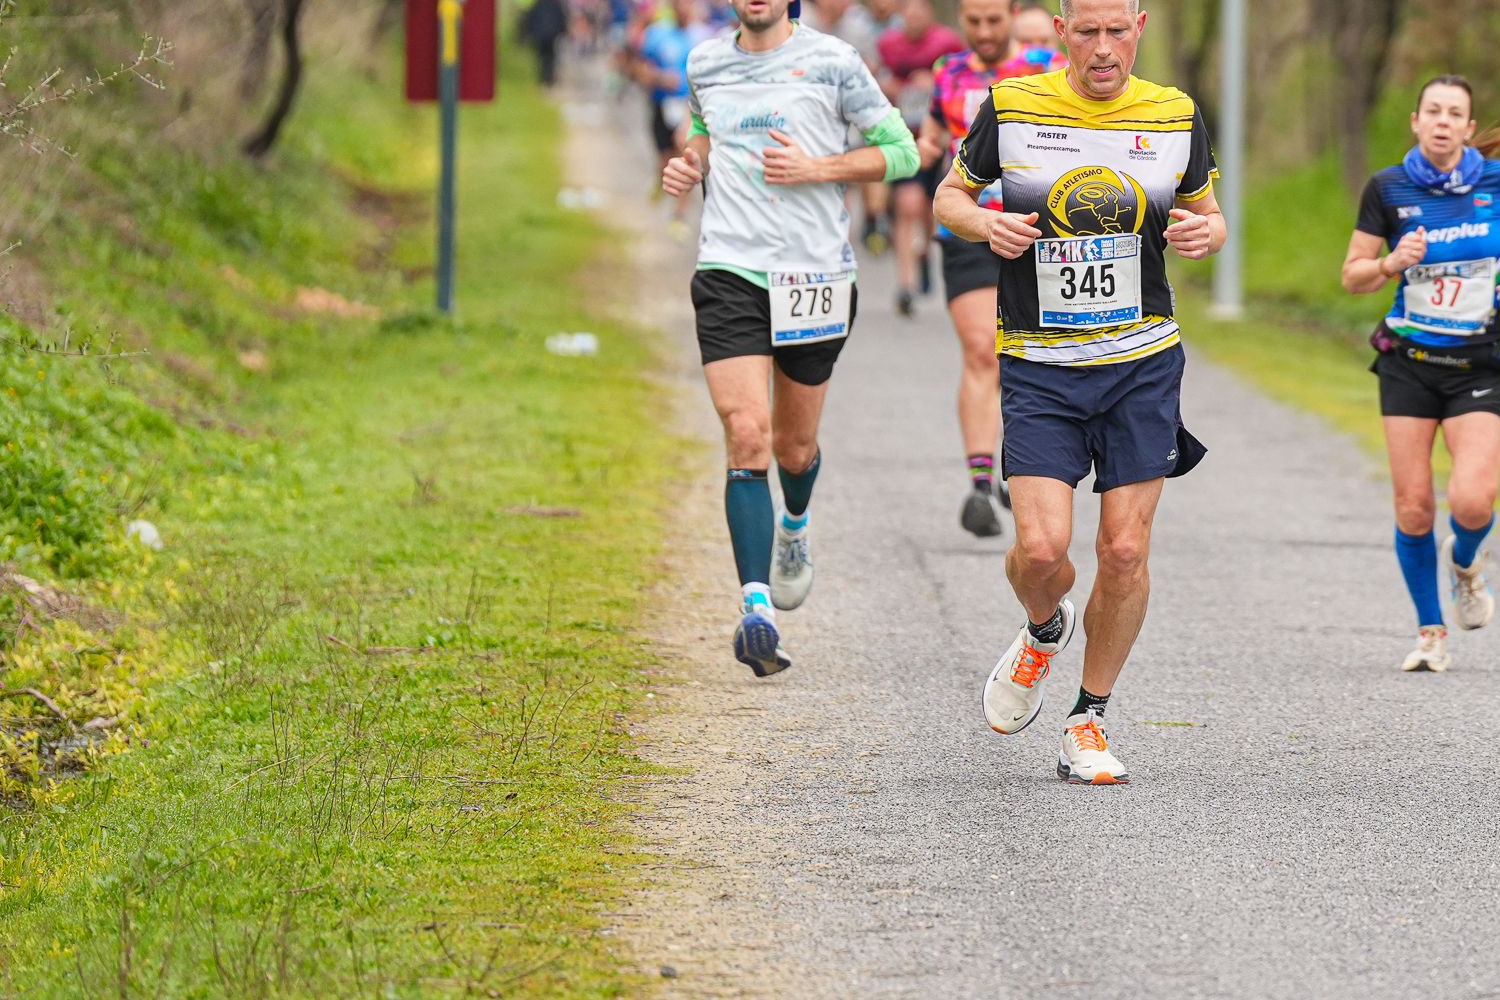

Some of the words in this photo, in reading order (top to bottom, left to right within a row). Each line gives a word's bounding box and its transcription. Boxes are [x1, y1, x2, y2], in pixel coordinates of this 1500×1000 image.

[1027, 144, 1080, 153] #teamperezcampos
[1036, 131, 1067, 140] FASTER
[1050, 189, 1064, 209] CLUB
[1063, 168, 1103, 190] ATLETISMO
[1050, 241, 1083, 262] 21K
[1060, 263, 1115, 299] 345
[1431, 277, 1462, 307] 37
[790, 286, 832, 317] 278
